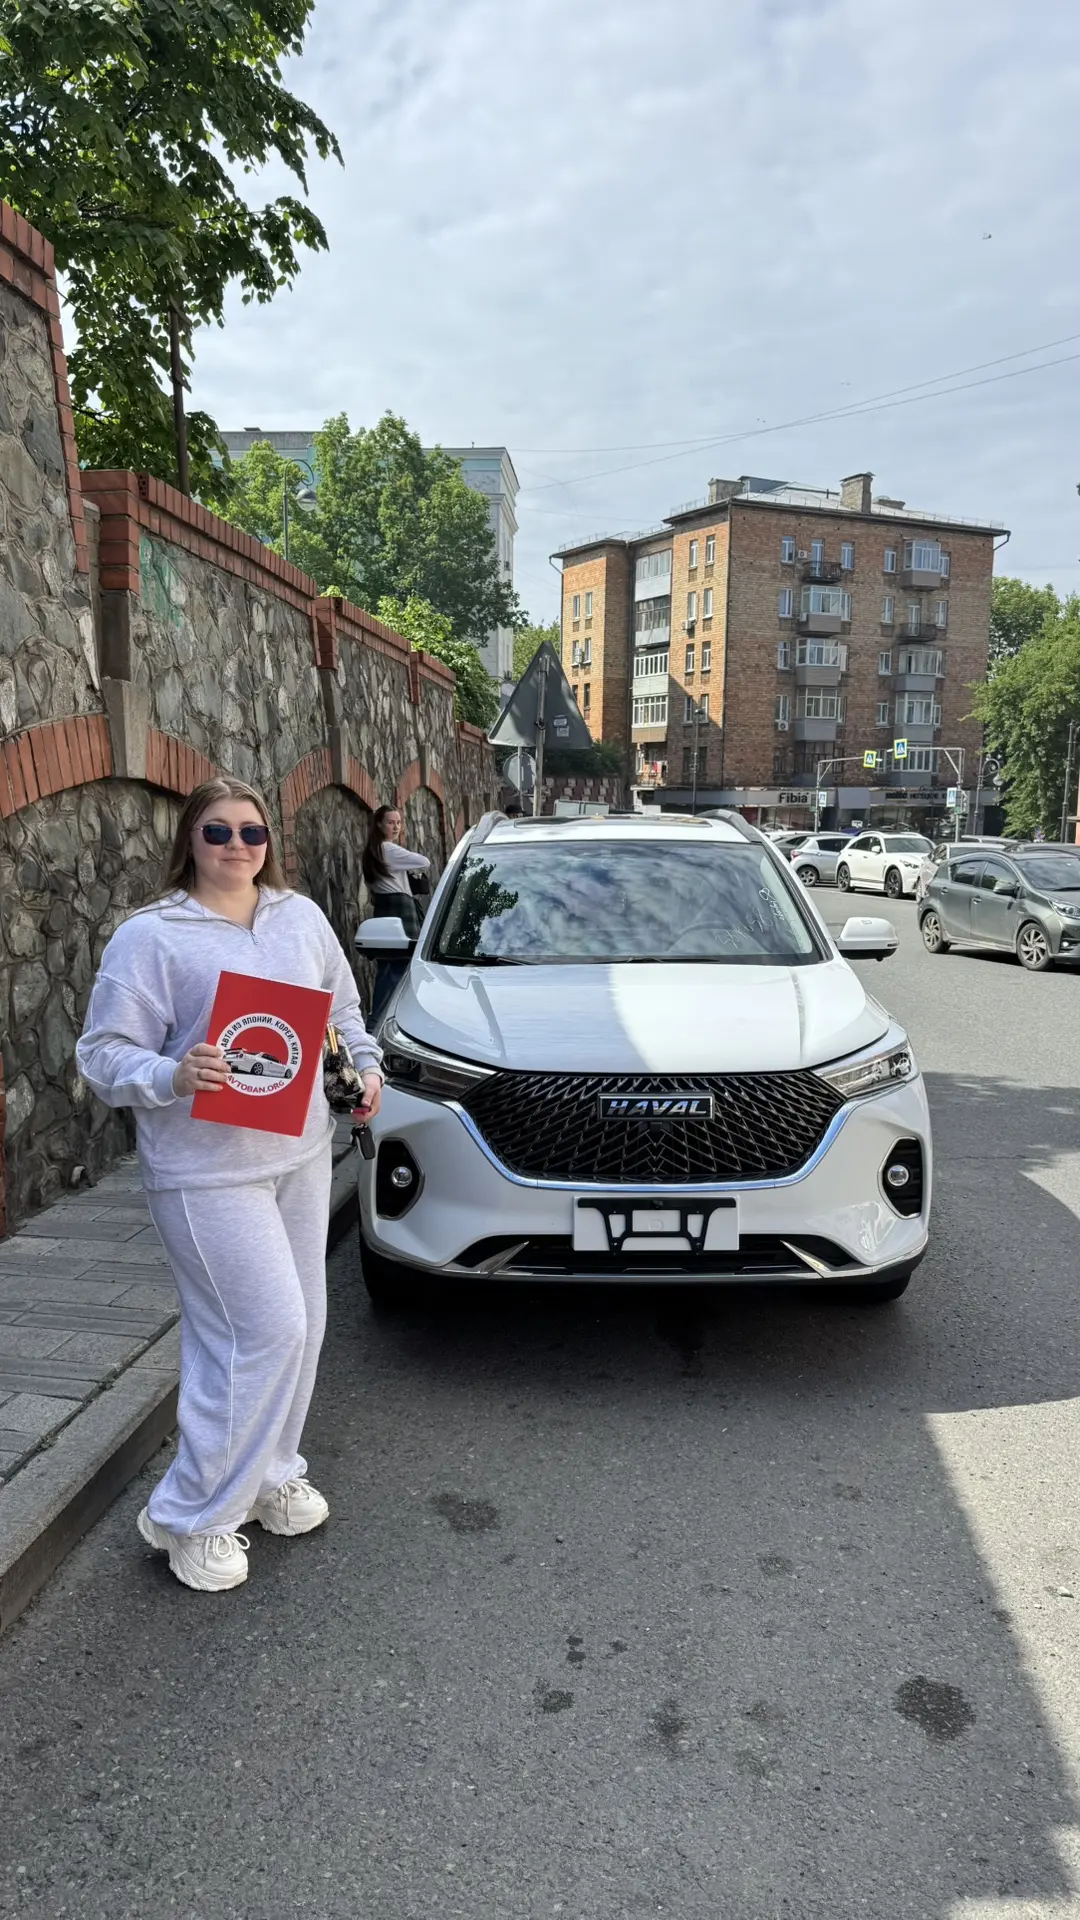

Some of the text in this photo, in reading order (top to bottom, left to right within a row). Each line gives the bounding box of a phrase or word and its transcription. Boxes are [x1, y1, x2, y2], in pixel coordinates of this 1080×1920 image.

[221, 1030, 234, 1048] АВТО
[231, 1021, 242, 1032] ИЗ
[291, 1042, 299, 1065] КИТАЯ
[227, 1075, 285, 1094] AVTOBAN.ORG
[606, 1100, 707, 1116] HAVAL
